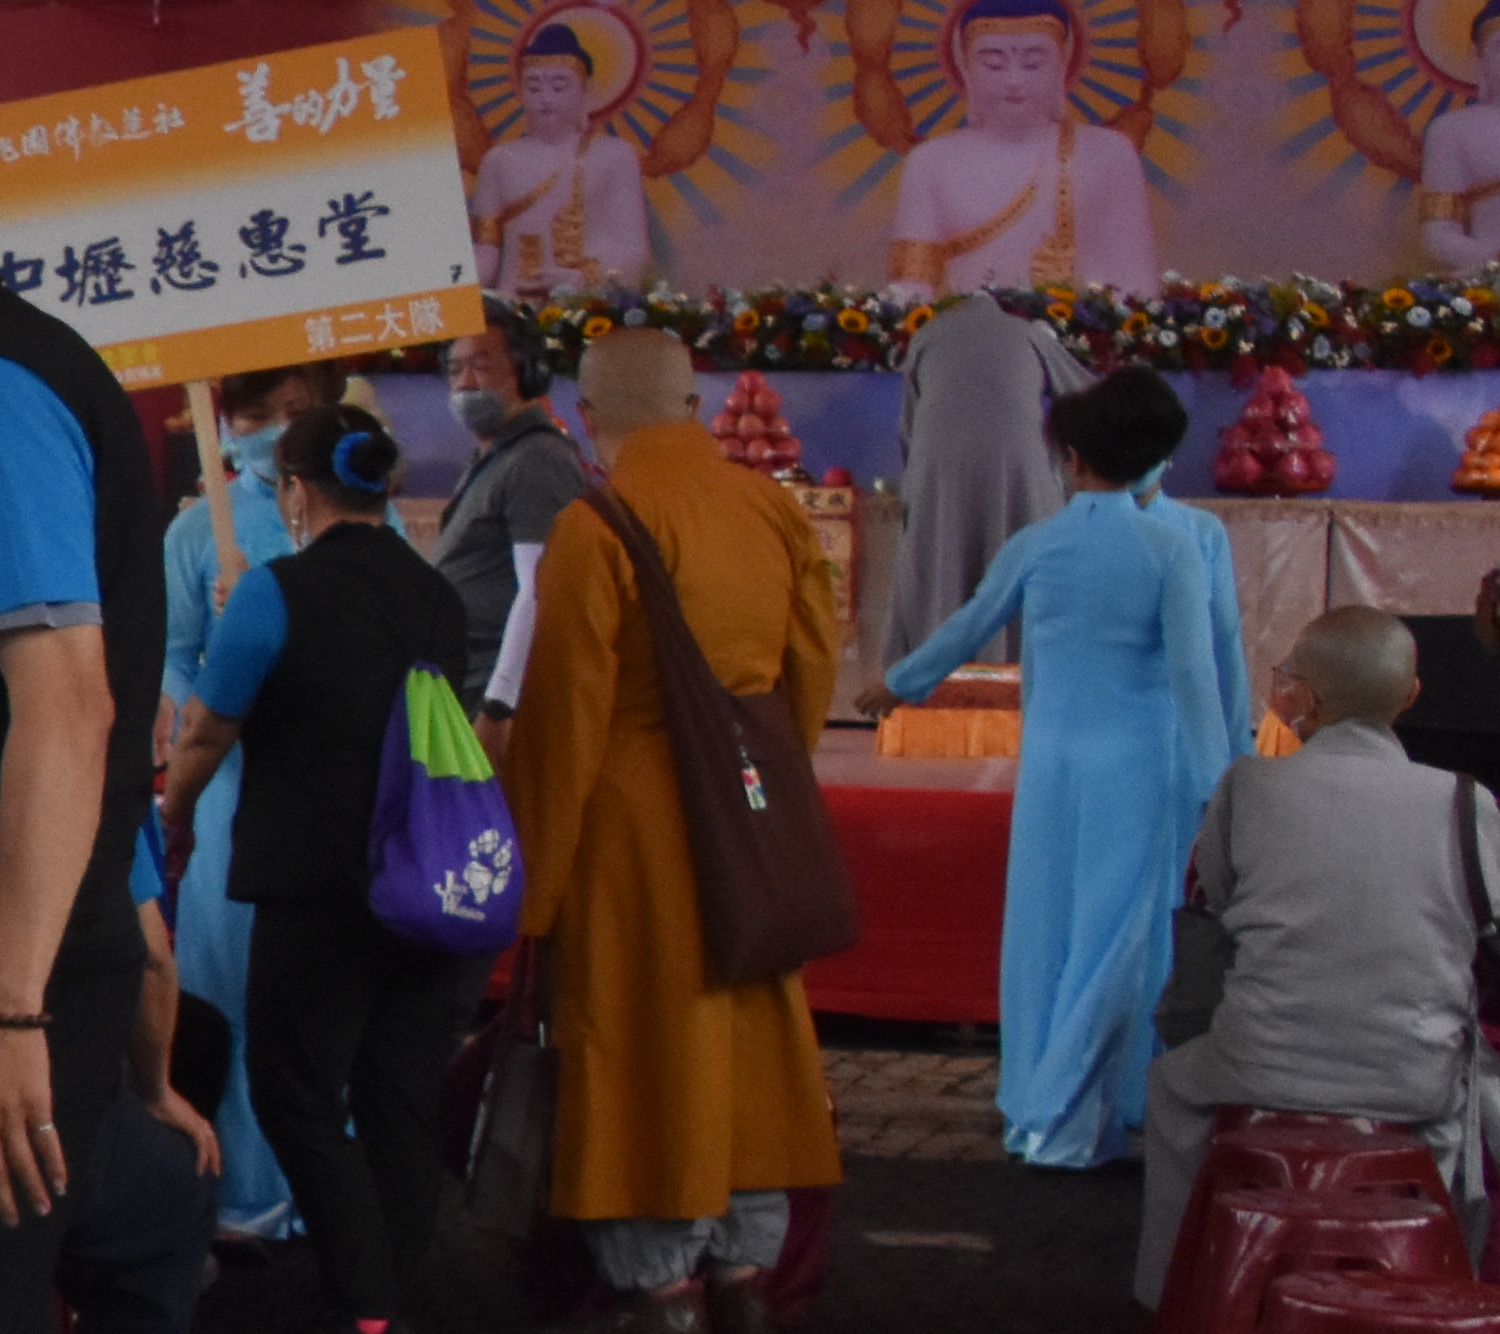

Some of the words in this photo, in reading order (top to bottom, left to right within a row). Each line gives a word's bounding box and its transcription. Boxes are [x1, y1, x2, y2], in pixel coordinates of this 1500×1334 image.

[223, 54, 406, 143] 善的力量
[303, 297, 446, 355] 第二大隊
